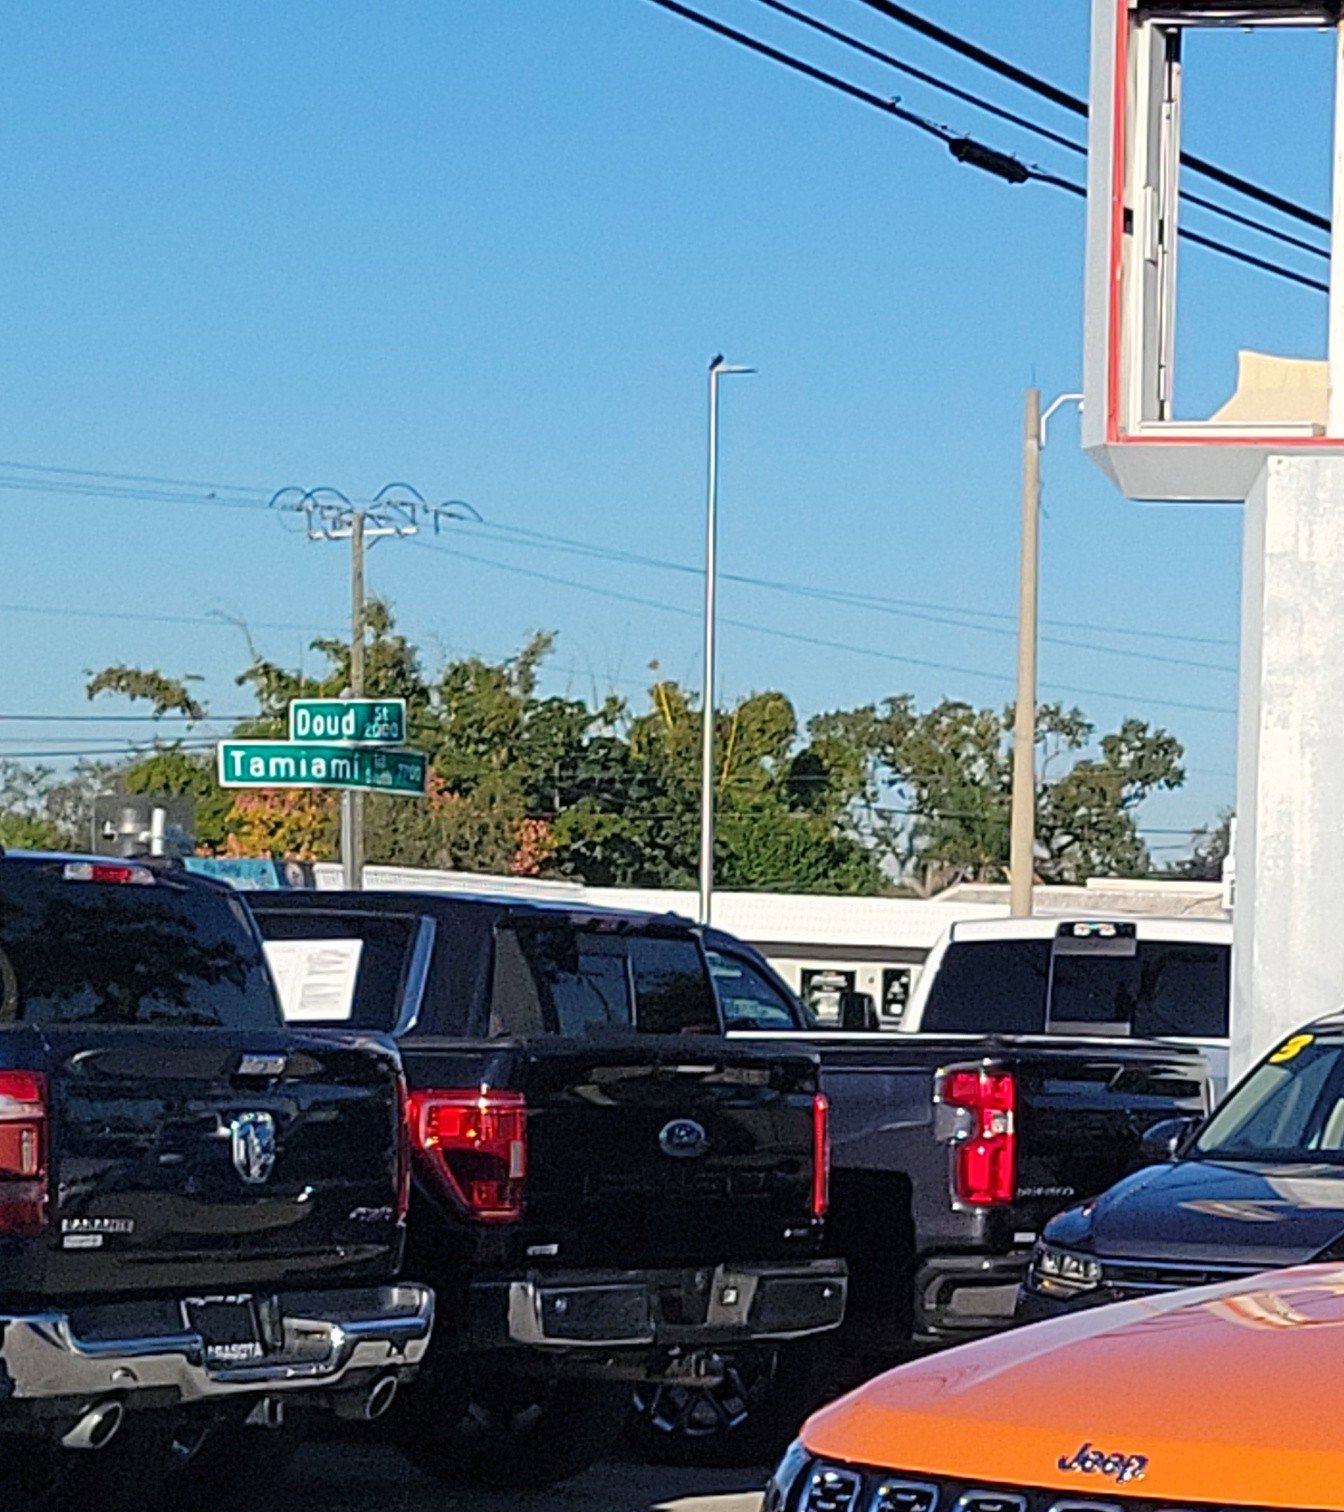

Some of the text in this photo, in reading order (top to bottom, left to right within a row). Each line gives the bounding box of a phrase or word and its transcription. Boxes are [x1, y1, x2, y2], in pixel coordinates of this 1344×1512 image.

[297, 708, 355, 736] Doud
[230, 750, 360, 780] Tamiami
[1058, 1443, 1149, 1484] Jeep
